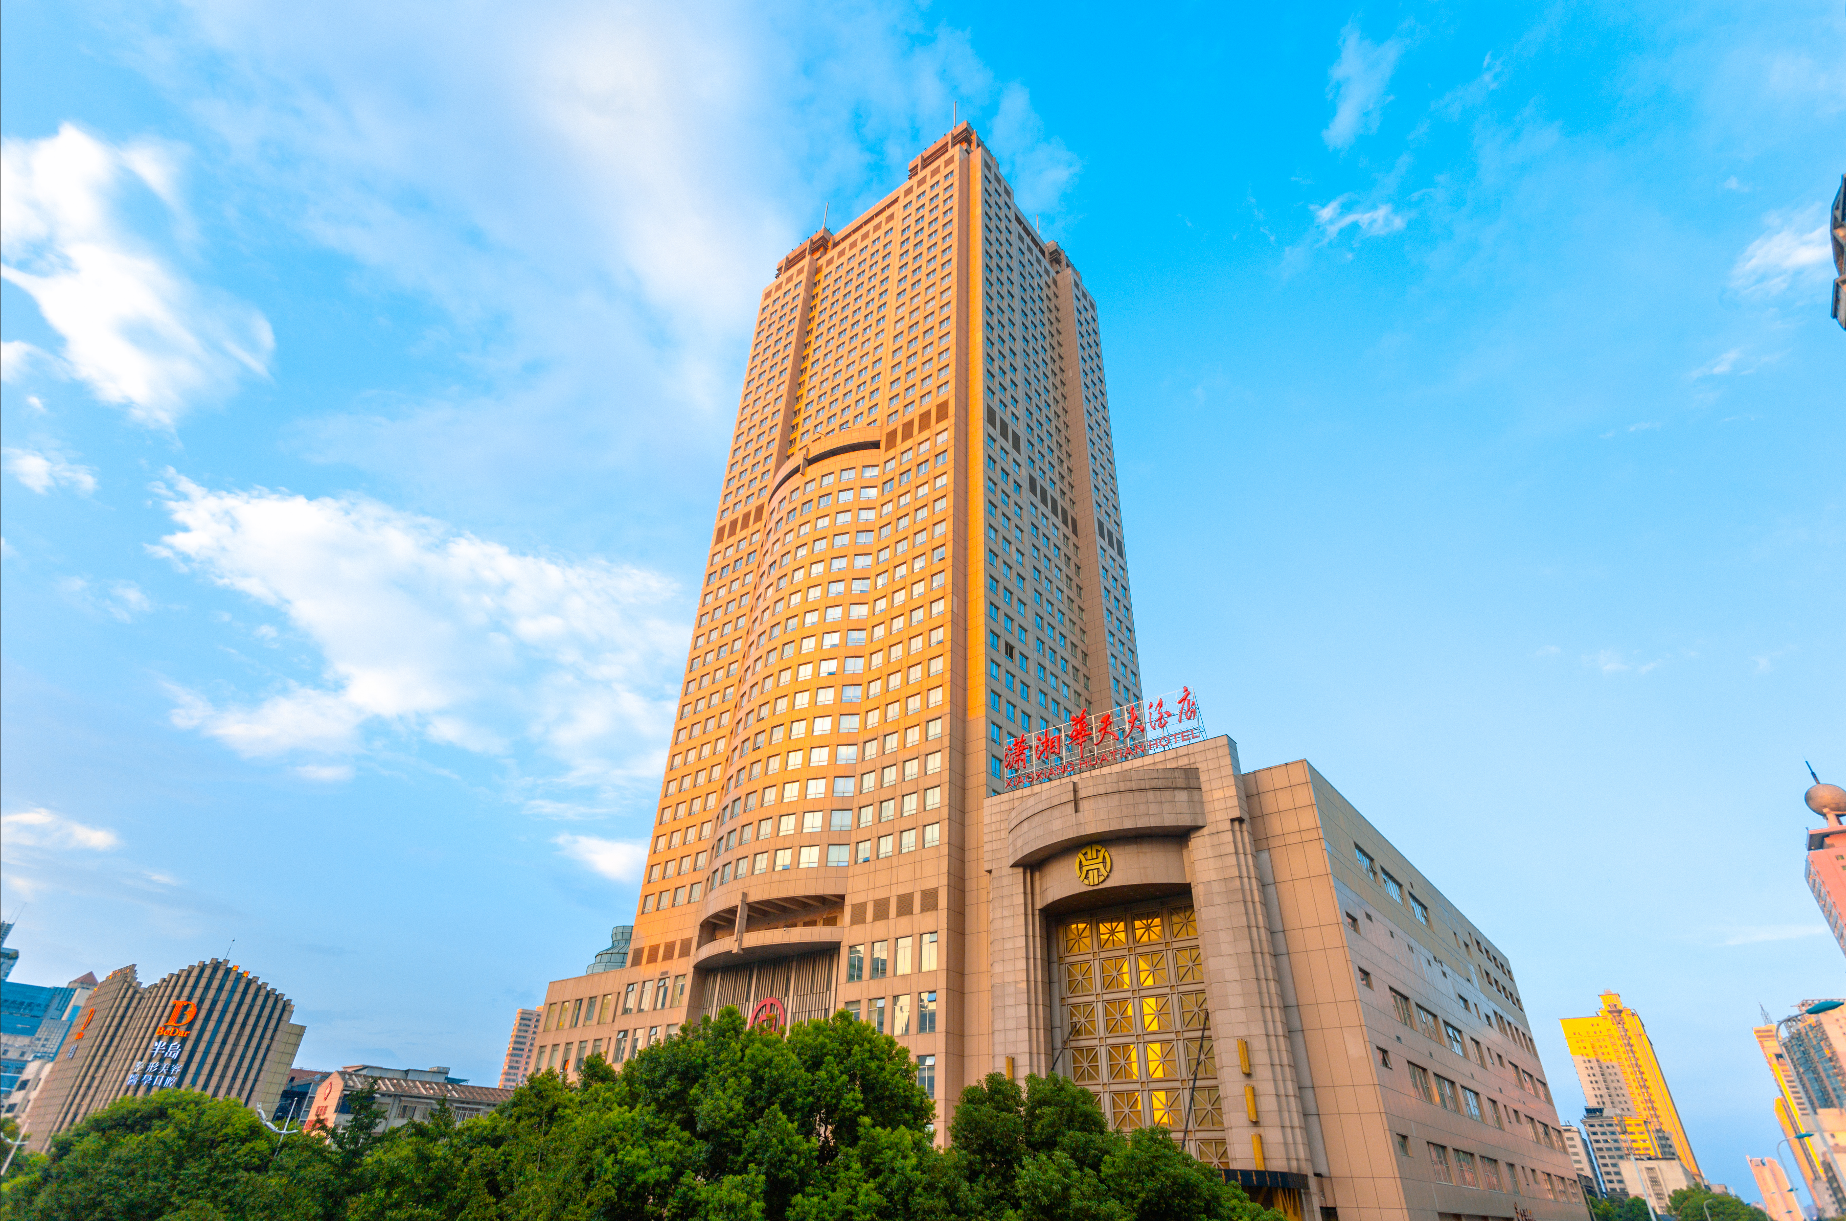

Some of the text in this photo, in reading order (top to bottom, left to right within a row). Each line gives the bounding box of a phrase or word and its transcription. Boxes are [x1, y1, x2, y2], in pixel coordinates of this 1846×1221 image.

[1005, 729, 1200, 788] XIAOXIANG HUATIAN HOTEL
